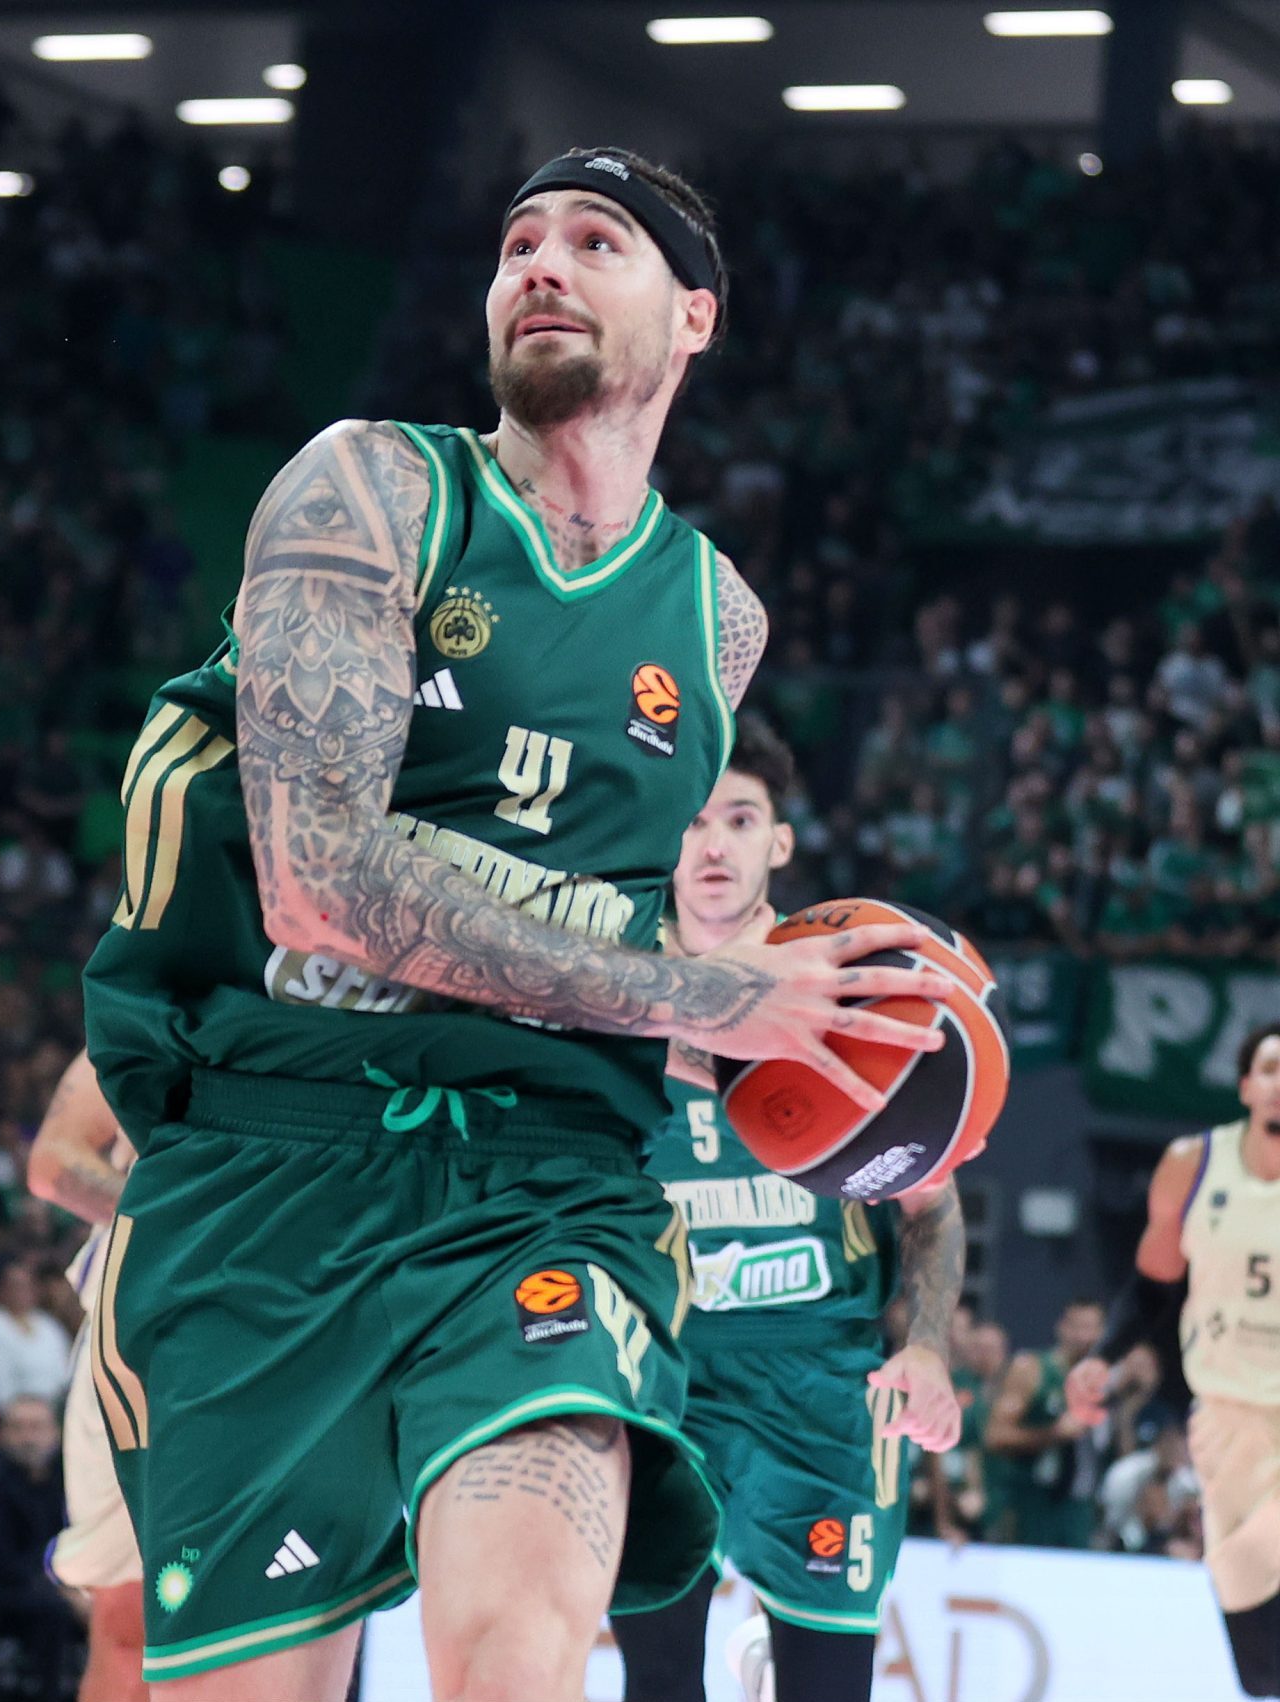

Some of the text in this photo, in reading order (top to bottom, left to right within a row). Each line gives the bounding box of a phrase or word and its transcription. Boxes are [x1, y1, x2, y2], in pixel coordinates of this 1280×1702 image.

[493, 725, 573, 835] 41
[686, 1100, 719, 1163] 5
[1245, 1252, 1272, 1299] 5
[180, 1544, 201, 1564] bp
[846, 1513, 875, 1593] 5
